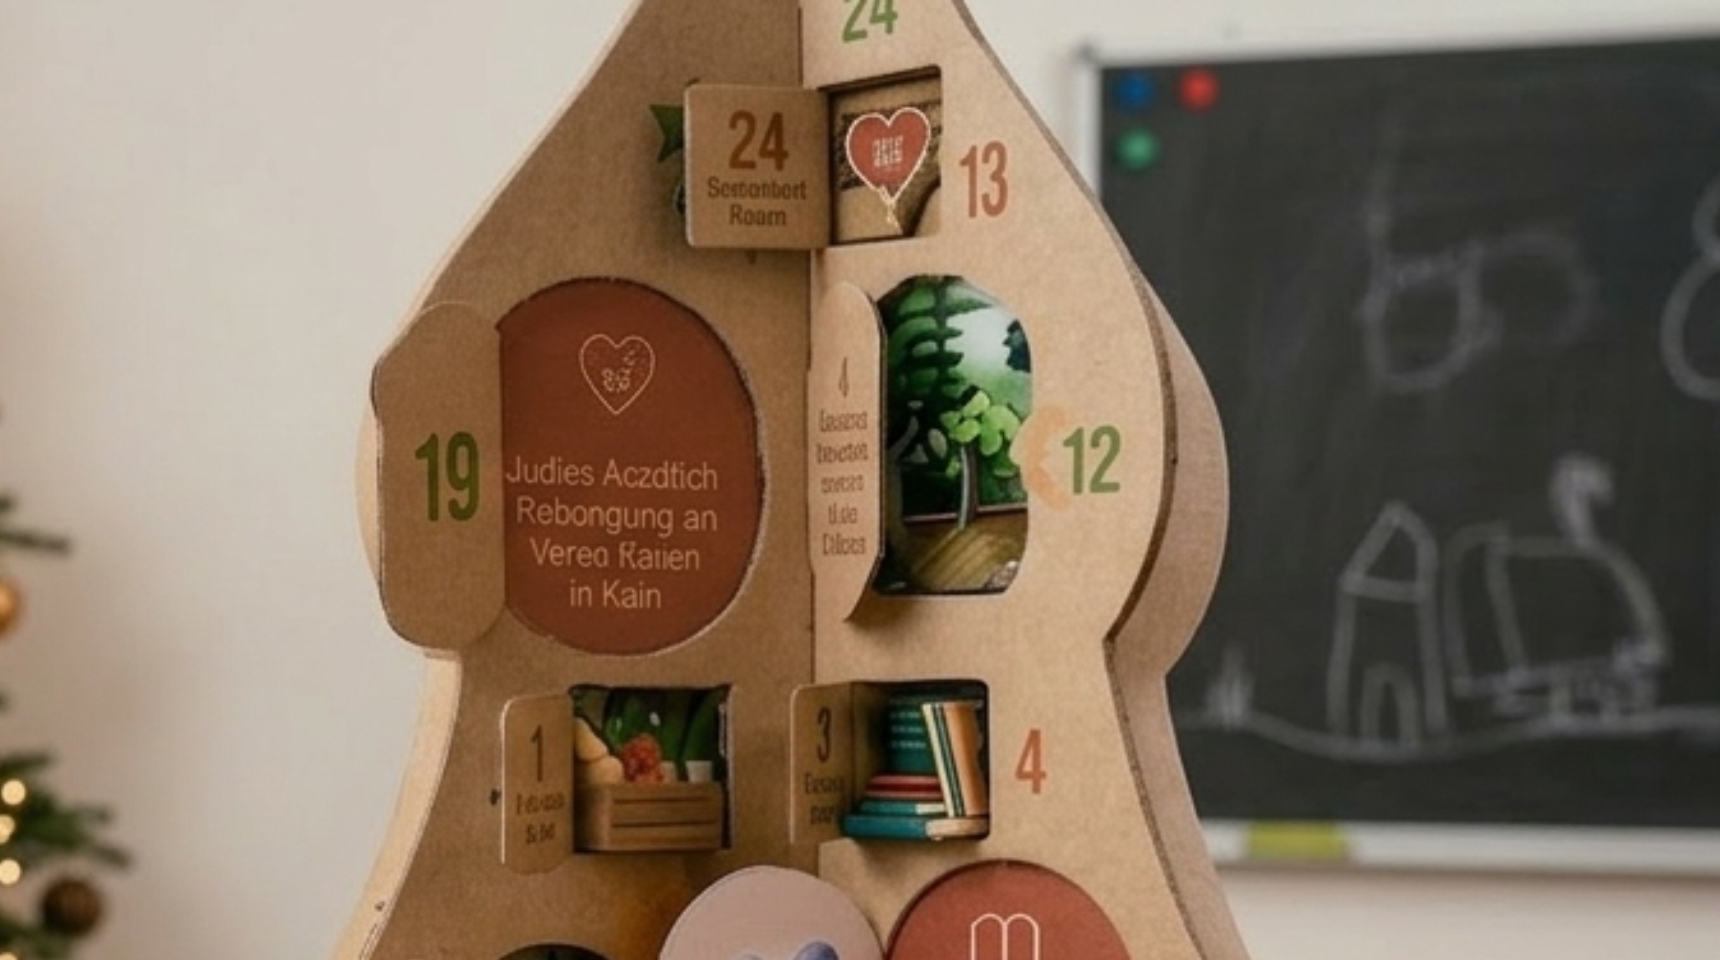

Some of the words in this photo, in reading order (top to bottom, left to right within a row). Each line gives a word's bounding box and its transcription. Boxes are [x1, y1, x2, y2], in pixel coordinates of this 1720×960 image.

[729, 109, 788, 171] 24
[959, 140, 1009, 219] 13
[414, 431, 479, 522] 19
[1063, 425, 1121, 494] 12
[516, 496, 674, 539] Rebongung
[683, 509, 718, 532] an
[570, 578, 592, 606] in
[603, 579, 661, 609] Kain
[531, 725, 543, 782] 1
[817, 707, 831, 763] 3
[1015, 728, 1047, 794] 4
